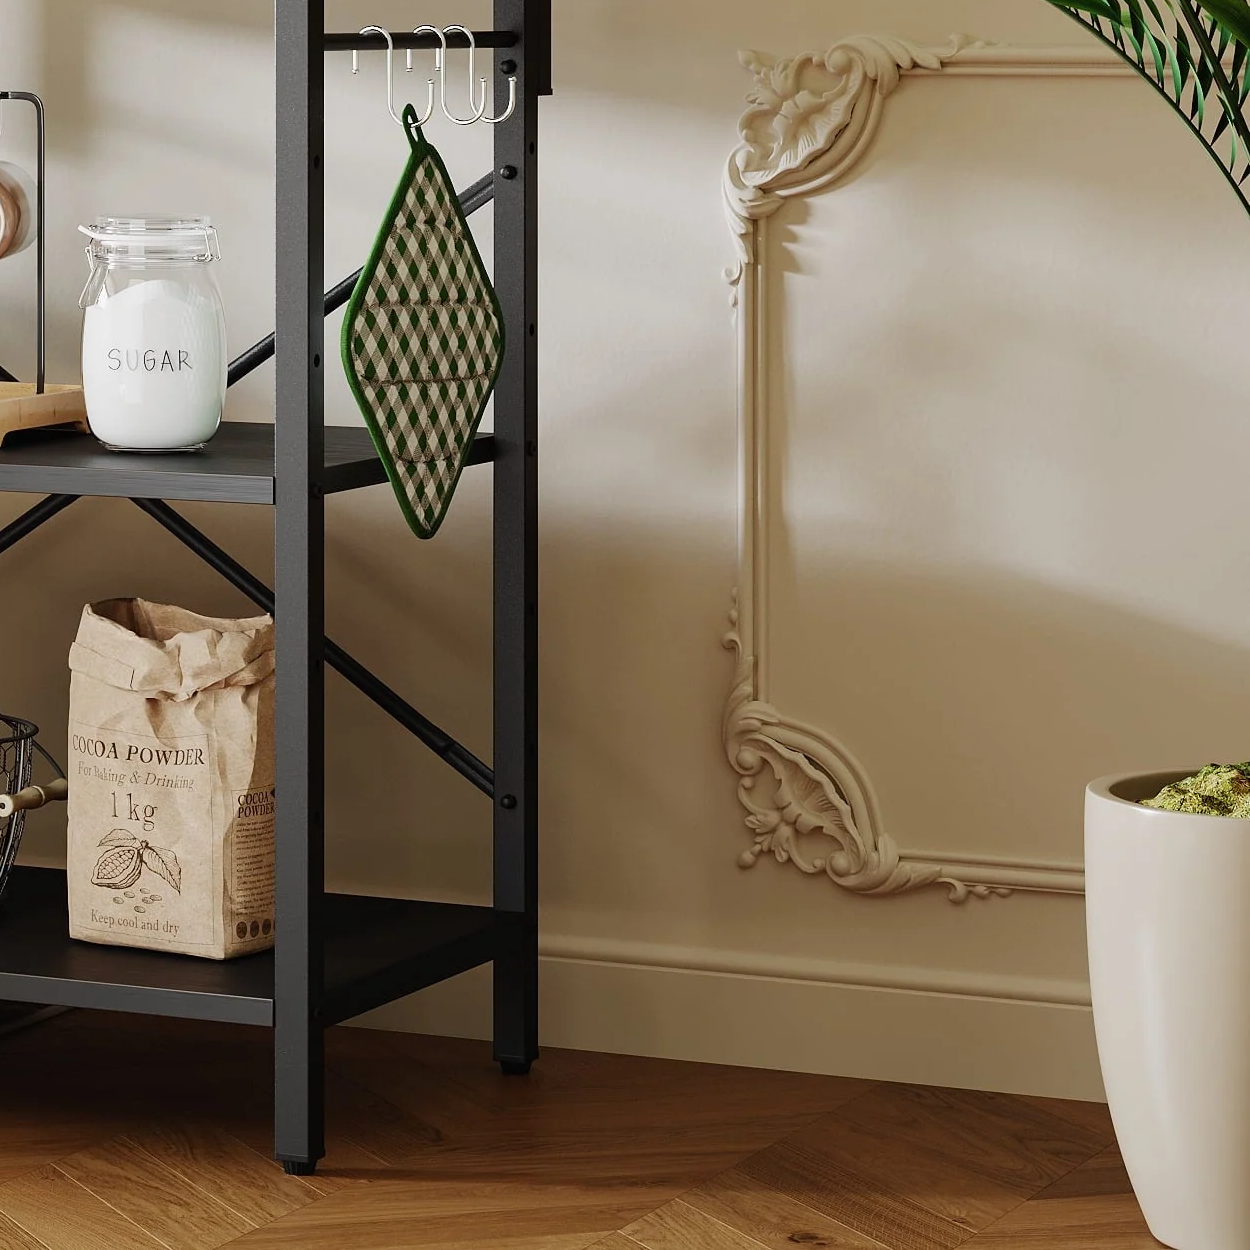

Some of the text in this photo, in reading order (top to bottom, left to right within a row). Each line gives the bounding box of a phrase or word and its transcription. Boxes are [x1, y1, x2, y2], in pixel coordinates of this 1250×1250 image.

[108, 348, 193, 373] SUGAR
[72, 734, 205, 765] COCOA POWDER
[78, 760, 195, 790] For Baking & Drinking
[111, 791, 158, 831] 1 kg
[237, 802, 275, 818] POWDER
[238, 791, 269, 806] COCOA
[90, 909, 180, 937] Keep cool and dry
